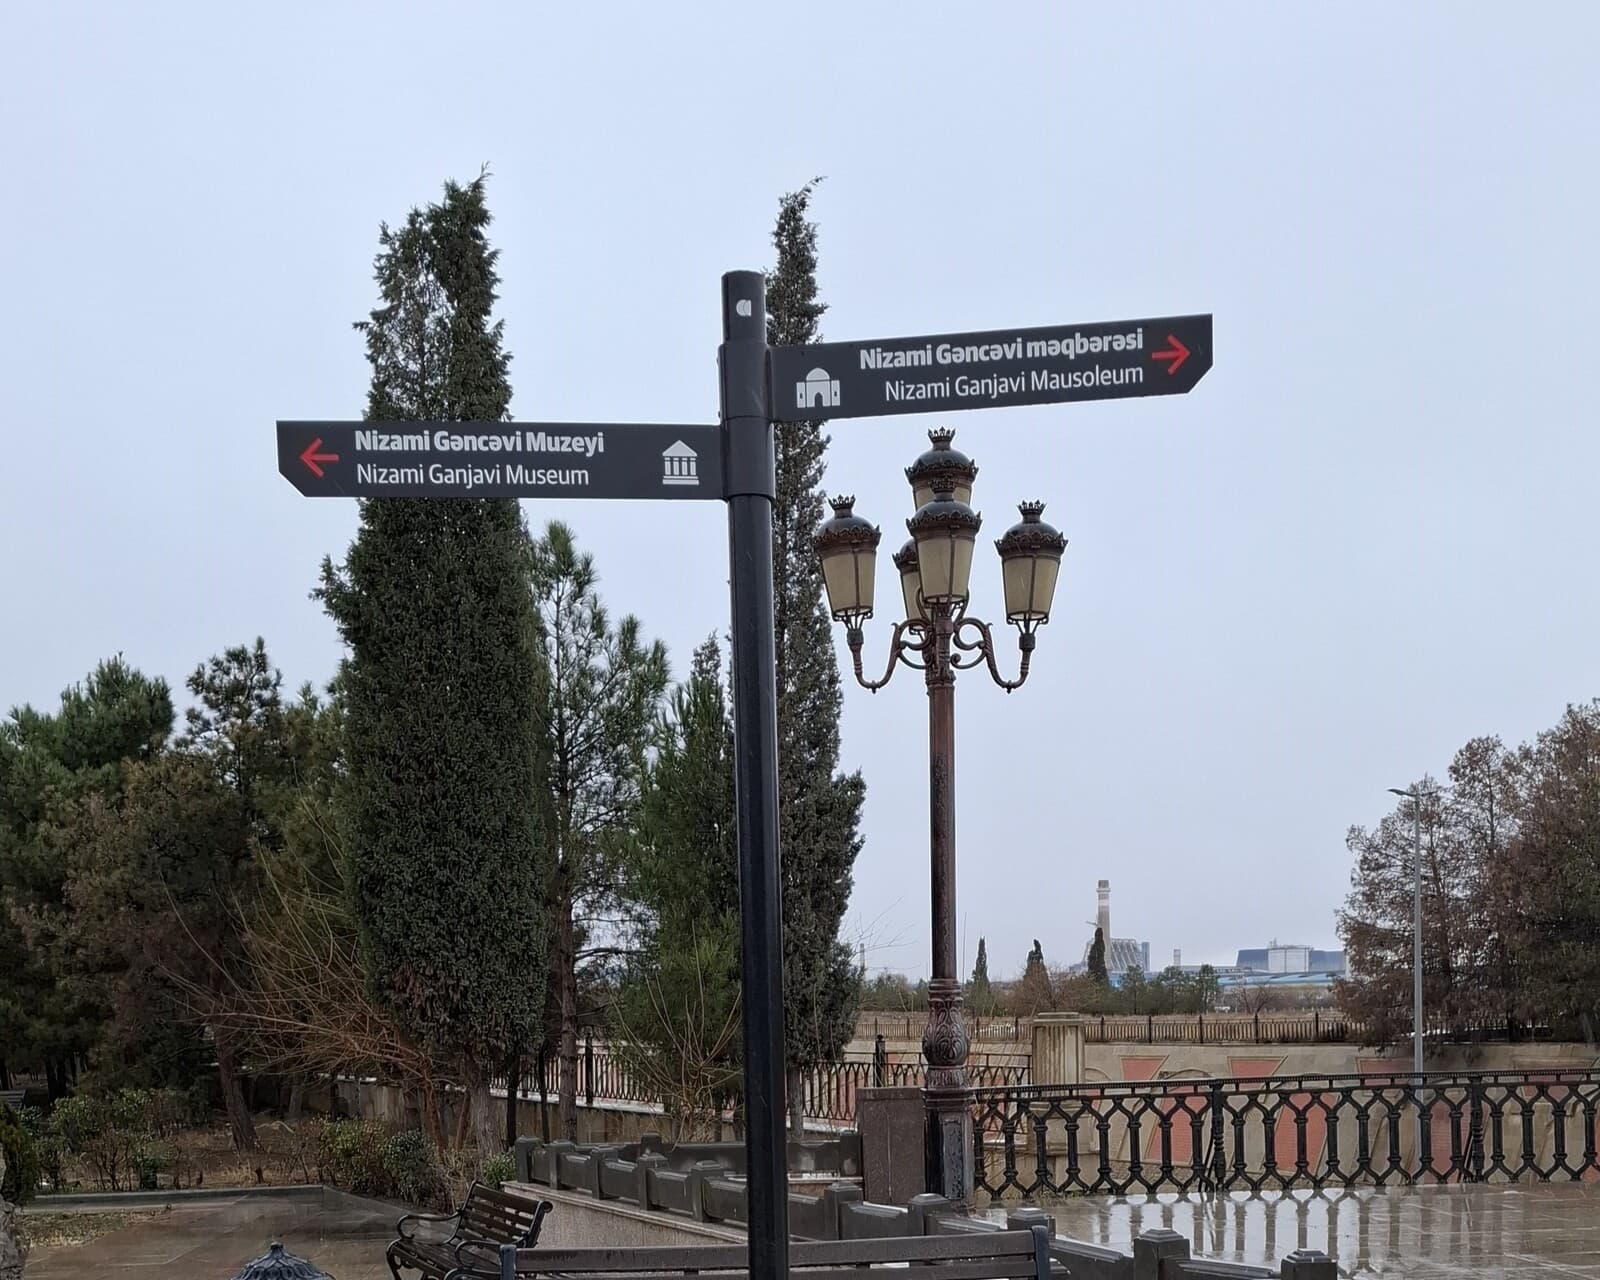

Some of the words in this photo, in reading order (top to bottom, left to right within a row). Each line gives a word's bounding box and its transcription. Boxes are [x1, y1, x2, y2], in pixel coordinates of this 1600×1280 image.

[859, 344, 933, 370] Nizami
[935, 337, 1023, 365] Gəncəvi
[1026, 327, 1143, 360] məqbərəsi
[885, 376, 950, 402] Nizami
[954, 371, 1026, 399] Ganjavi
[1030, 364, 1144, 392] Mausoleum
[354, 429, 431, 451] Nizami
[433, 430, 522, 452] Gəncəvi
[525, 431, 605, 457] Muzeyi
[357, 463, 424, 484] Nizami
[428, 463, 501, 489] Ganjavi
[505, 464, 589, 485] Museum
